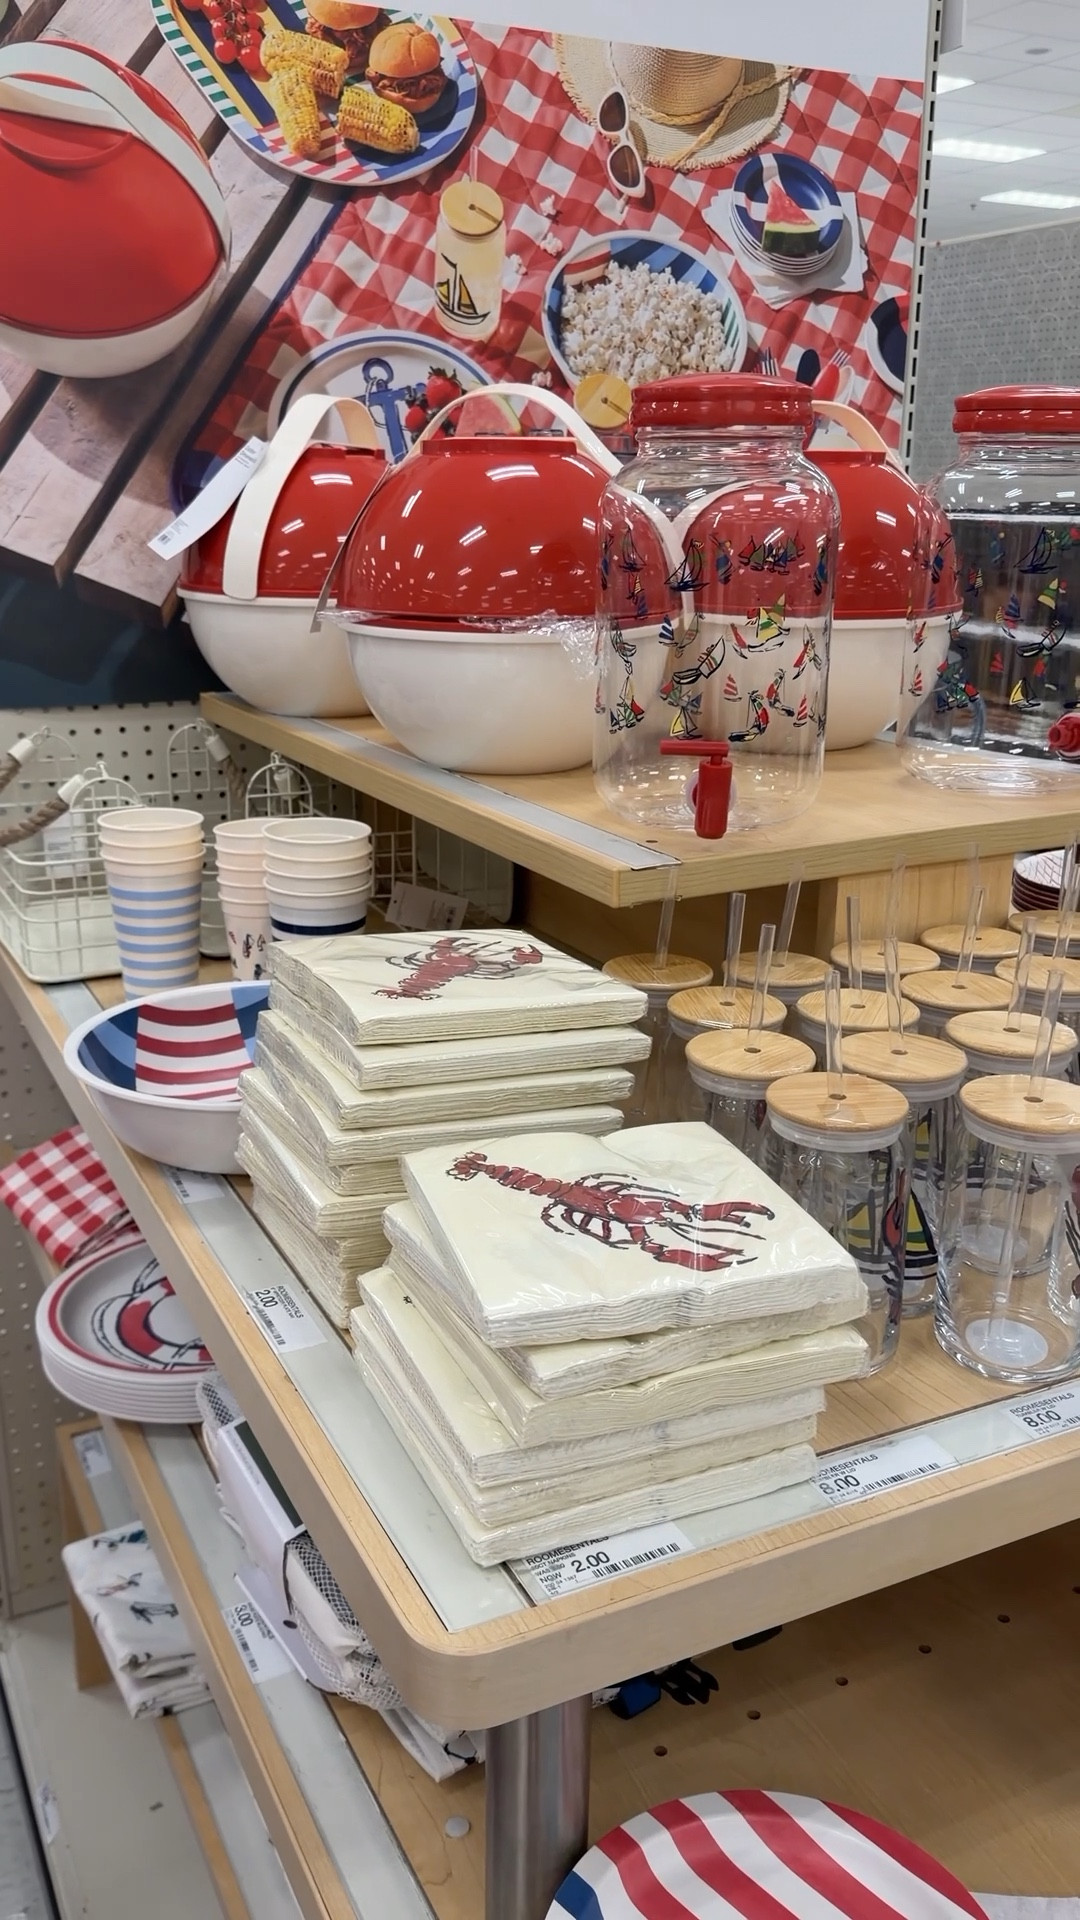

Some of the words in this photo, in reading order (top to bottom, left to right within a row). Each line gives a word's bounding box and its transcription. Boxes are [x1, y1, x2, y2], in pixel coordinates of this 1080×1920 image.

[255, 1289, 278, 1307] 2.00
[1023, 1410, 1061, 1427] 8.00
[809, 1454, 878, 1481] OMESENTALS
[818, 1474, 861, 1495] 8.00
[540, 1572, 562, 1583] NOW
[570, 1551, 611, 1573] 2.00
[235, 1604, 253, 1627] 3.00
